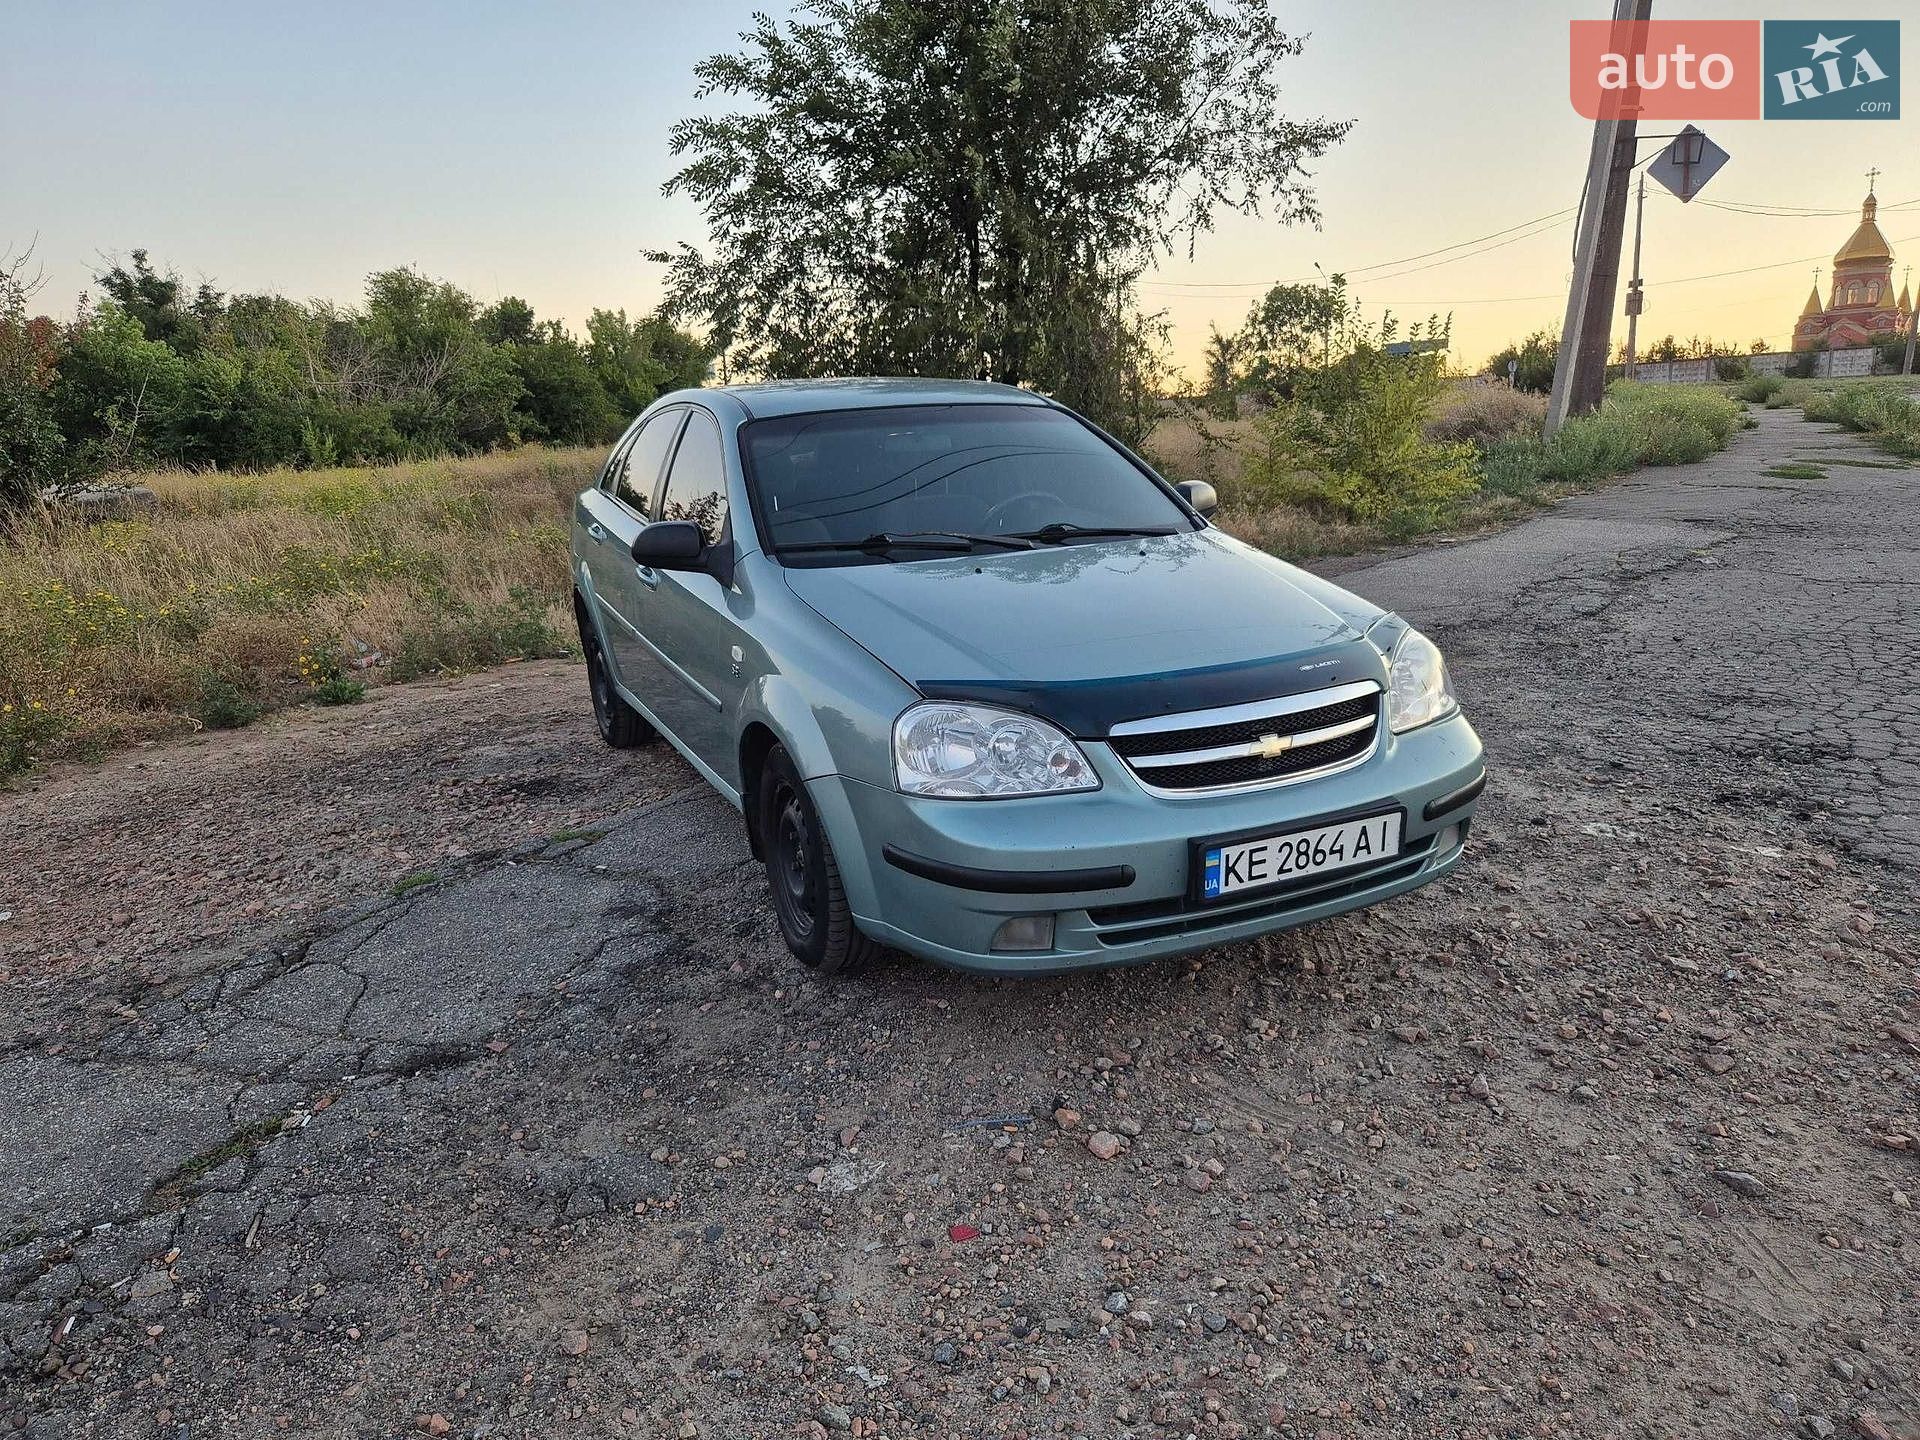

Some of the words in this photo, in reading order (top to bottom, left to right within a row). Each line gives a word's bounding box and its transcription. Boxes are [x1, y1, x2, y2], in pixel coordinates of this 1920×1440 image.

[1224, 845, 1268, 887] KE
[1277, 829, 1344, 875] 2864
[1204, 878, 1219, 891] UA
